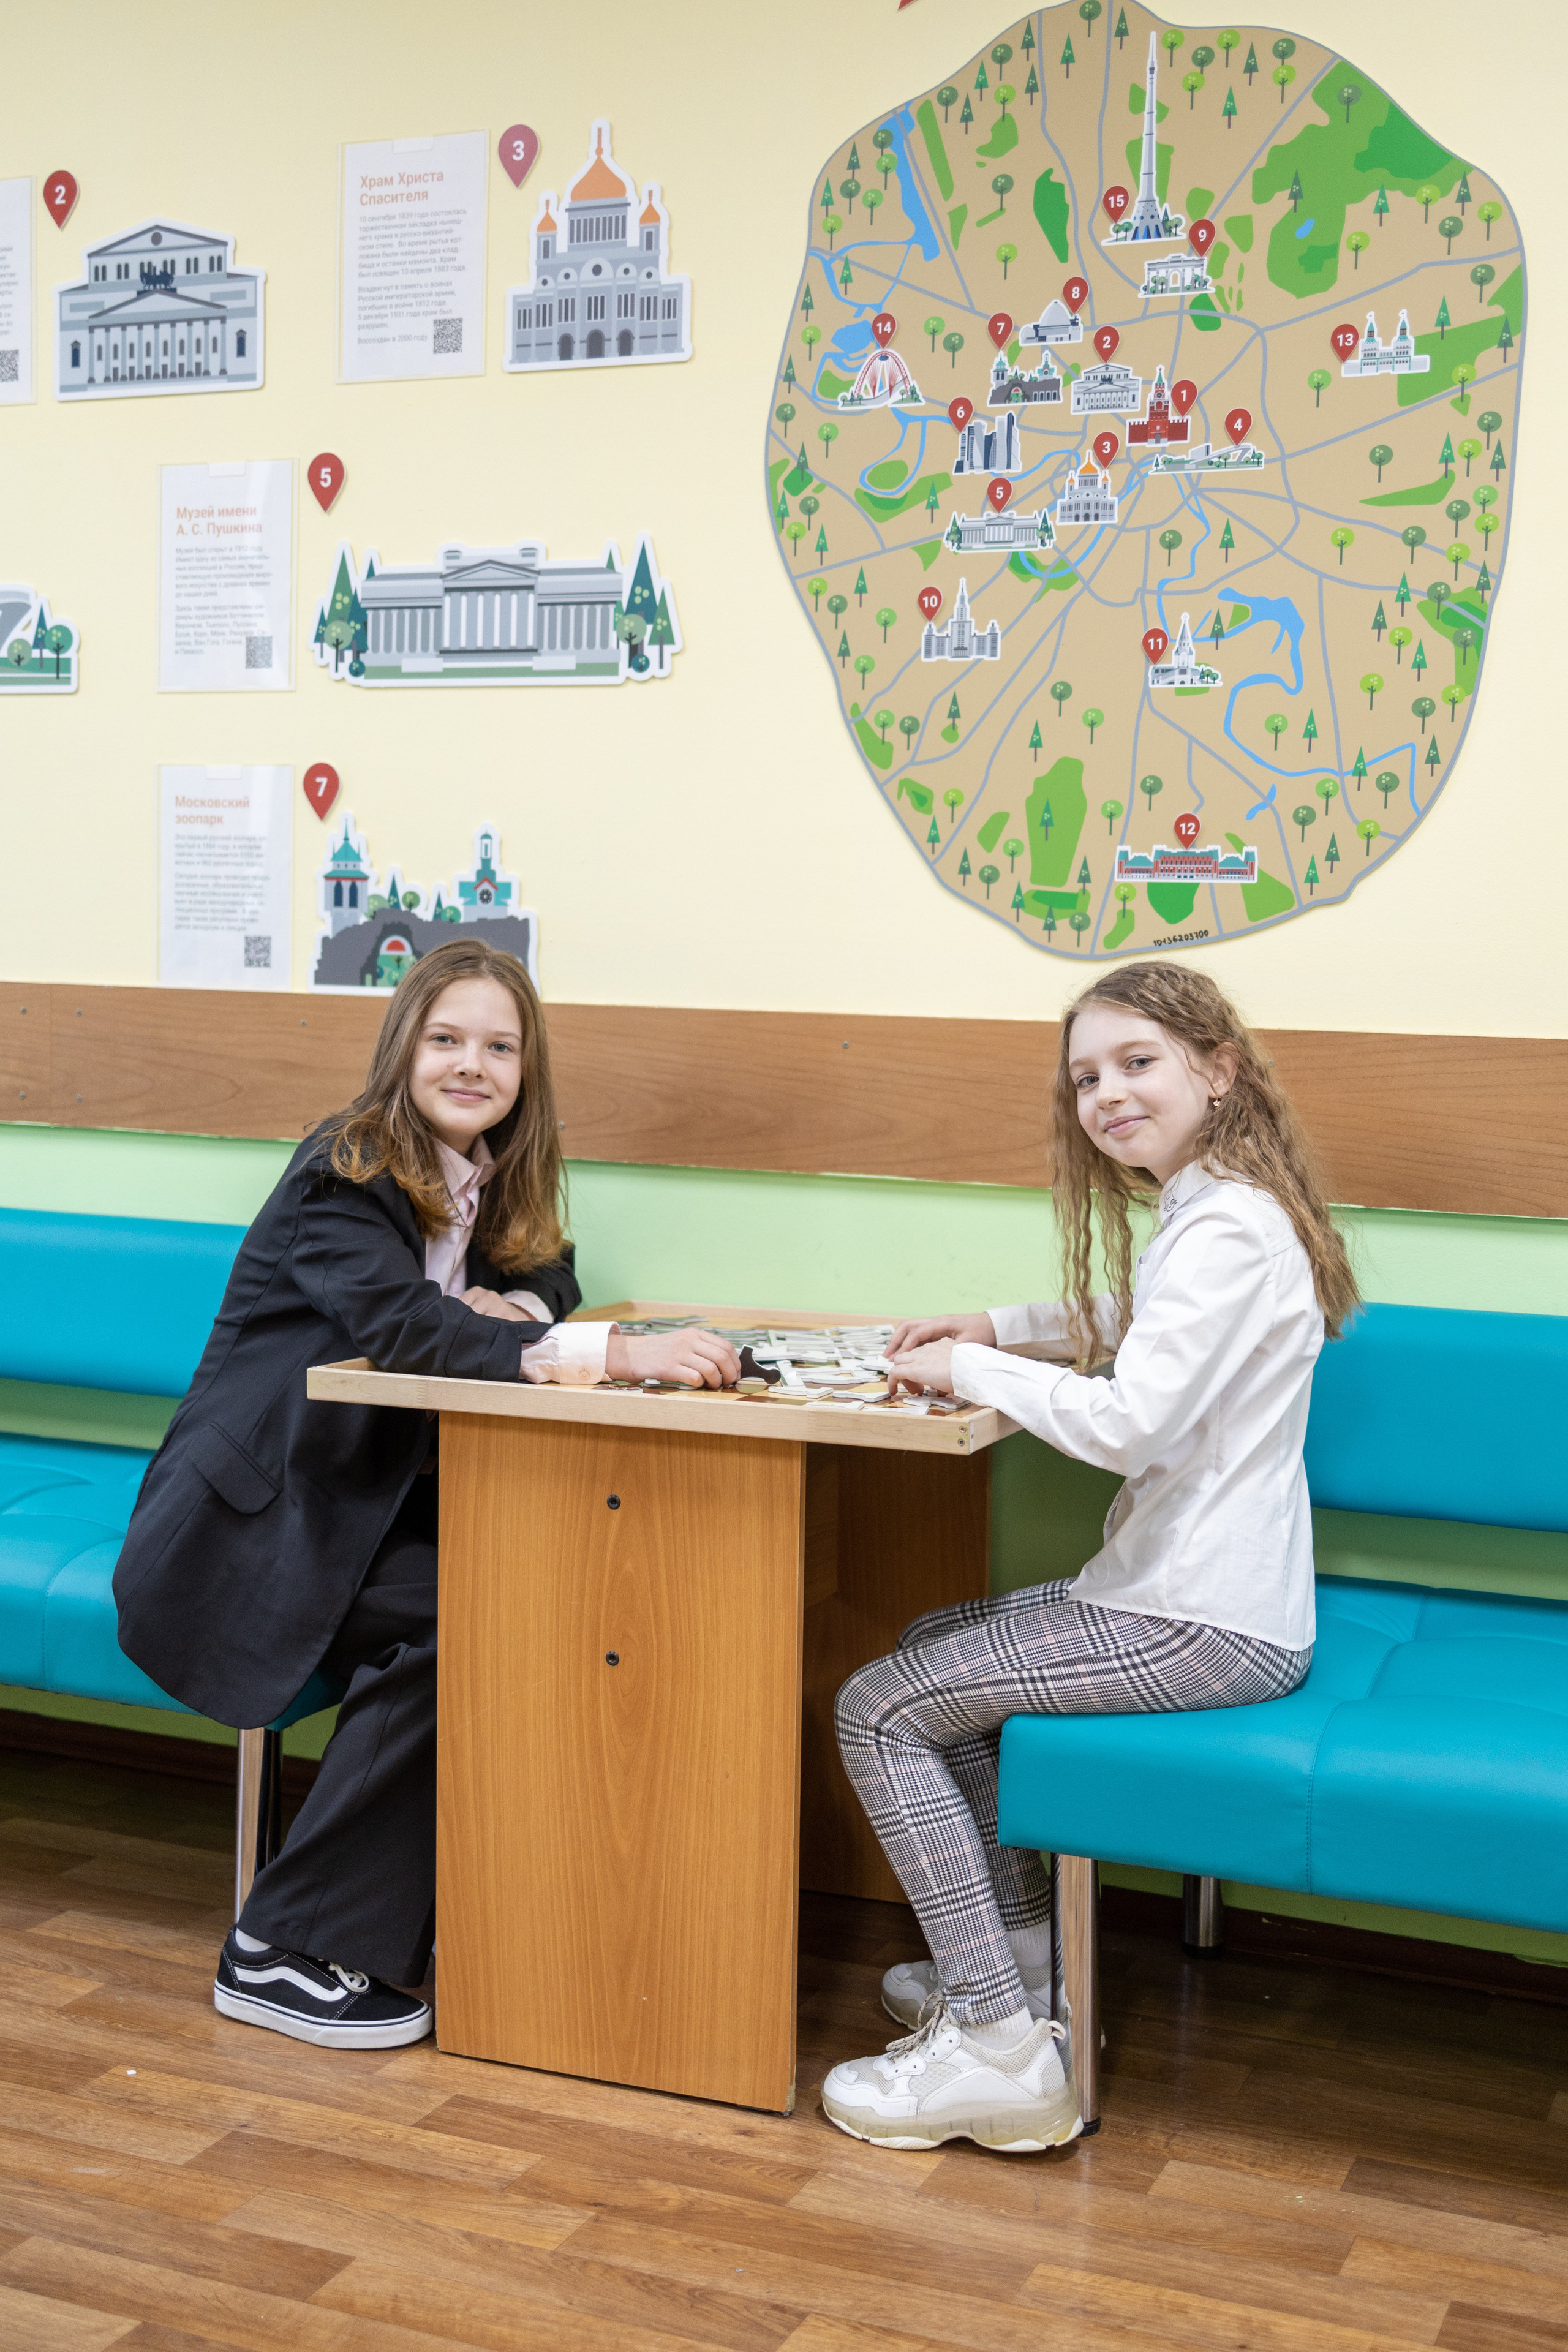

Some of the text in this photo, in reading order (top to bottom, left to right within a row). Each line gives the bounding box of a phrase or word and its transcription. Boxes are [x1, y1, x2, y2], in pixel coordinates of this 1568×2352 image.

[512, 140, 525, 161] 3
[360, 172, 444, 190] Храм Христа
[55, 185, 66, 205] 2
[360, 190, 429, 206] Спасителя
[1108, 194, 1125, 208] 15
[1198, 229, 1207, 242] 9
[1071, 286, 1080, 299] 8
[876, 321, 892, 334] 14
[997, 322, 1005, 335] 7
[1102, 336, 1111, 349] 2
[1336, 333, 1354, 347] 13
[1180, 390, 1186, 402] 1
[957, 406, 965, 418] 6
[1234, 418, 1243, 431] 4
[1102, 441, 1111, 454] 3
[320, 467, 332, 488] 5
[995, 486, 1004, 499] 5
[176, 506, 257, 522] Музей имени
[176, 522, 262, 537] А. С. Пушкина
[922, 595, 938, 608] 10
[1148, 638, 1163, 650] 11
[315, 777, 328, 797] 7
[175, 795, 249, 808] Московский
[175, 815, 224, 827] зоопарк
[1180, 822, 1196, 835] 12
[1153, 930, 1209, 946] 10136203700
